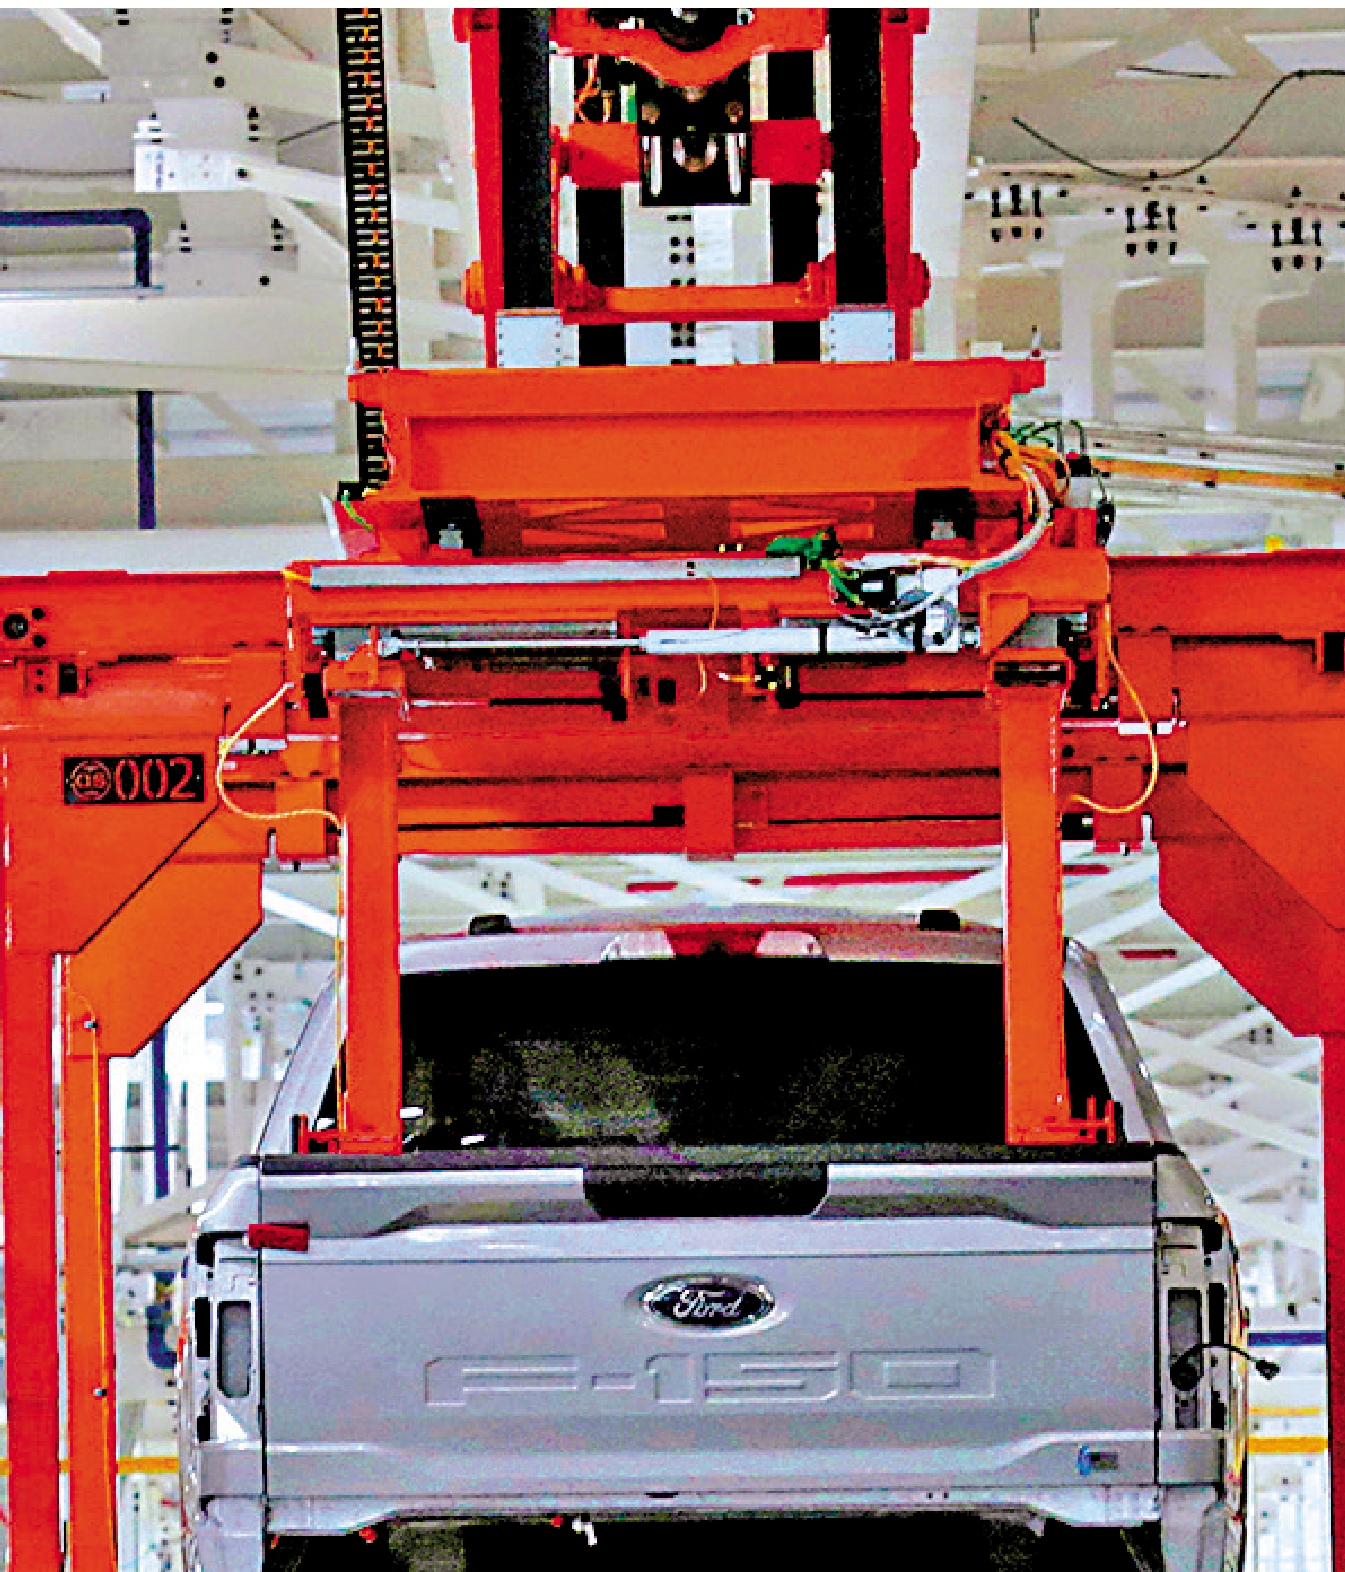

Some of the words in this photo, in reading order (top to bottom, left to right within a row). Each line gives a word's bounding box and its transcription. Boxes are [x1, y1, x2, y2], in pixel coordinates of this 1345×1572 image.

[115, 757, 196, 800] 002
[672, 1288, 743, 1318] Ford
[424, 1348, 996, 1406] F-150
